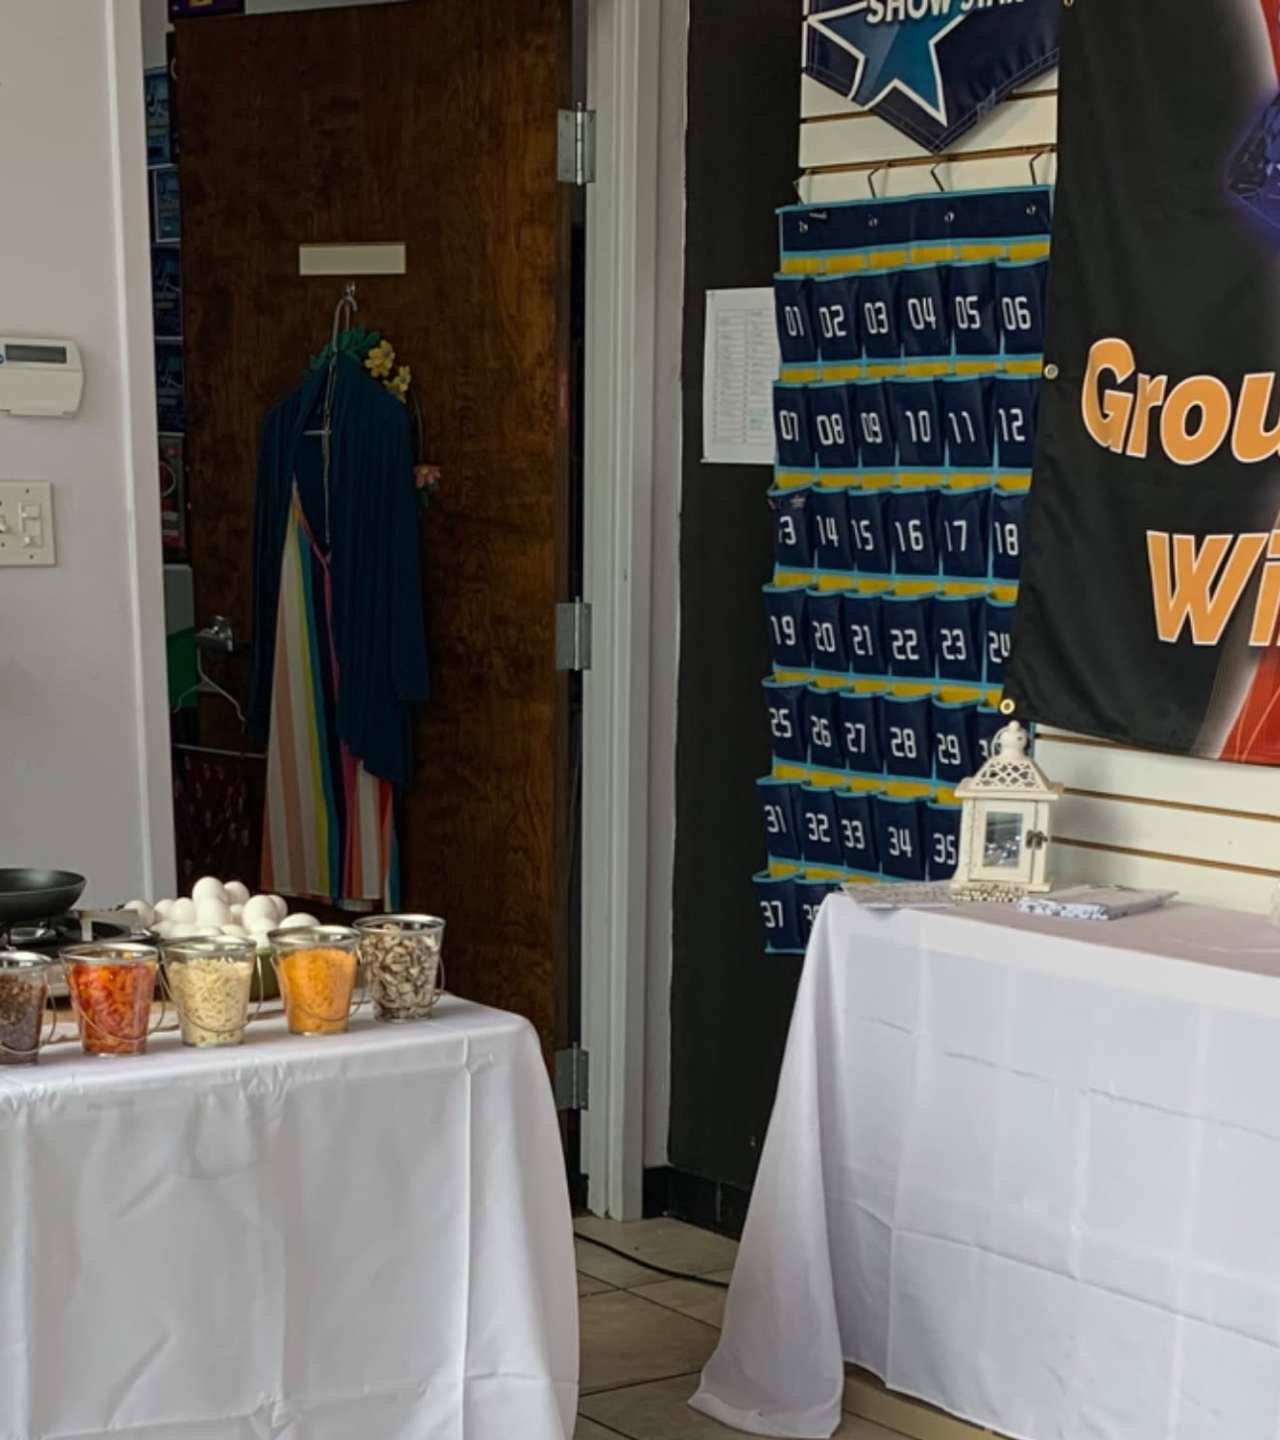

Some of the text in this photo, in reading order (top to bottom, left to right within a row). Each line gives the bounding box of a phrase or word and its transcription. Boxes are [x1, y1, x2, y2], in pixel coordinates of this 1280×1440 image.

[784, 295, 1032, 339] 01 02 03 04 05 06
[779, 407, 1026, 446] 07 08 09 10 11 12
[816, 515, 839, 547] 14
[851, 519, 874, 551] 15
[894, 519, 924, 552] 16
[944, 519, 967, 552] 17
[993, 521, 1019, 556] 18
[770, 615, 1011, 664] 19 20 21 22 23 24
[769, 707, 792, 738] 25
[810, 715, 832, 748] 26
[844, 722, 866, 753] 27
[889, 726, 917, 759] 28
[936, 732, 961, 765] 29
[764, 804, 957, 865] 31 32 33 34 35
[760, 900, 784, 928] 37
